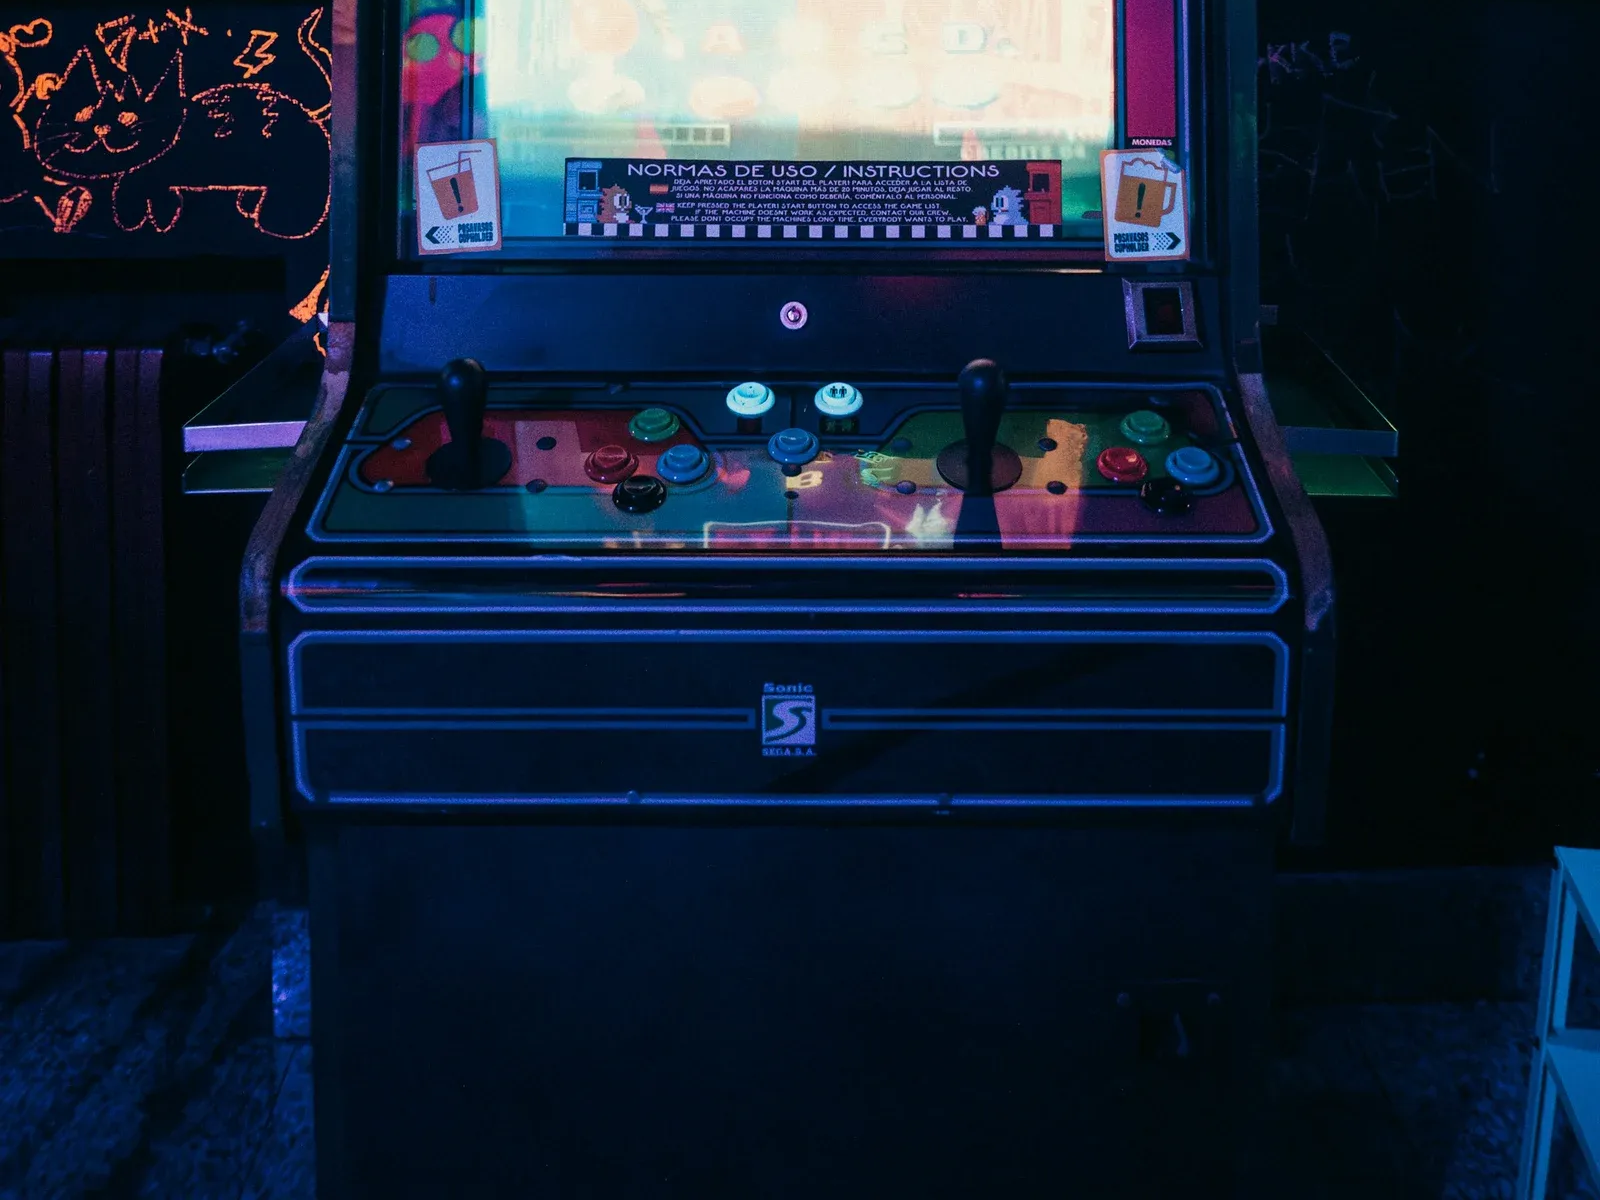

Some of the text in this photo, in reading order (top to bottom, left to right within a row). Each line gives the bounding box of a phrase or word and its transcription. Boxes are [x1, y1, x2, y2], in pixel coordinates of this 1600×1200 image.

[1131, 139, 1172, 147] MONEDAS
[627, 164, 1000, 177] NORMAS DE USO / INSTRUCTIONS
[762, 682, 814, 693] Sonic
